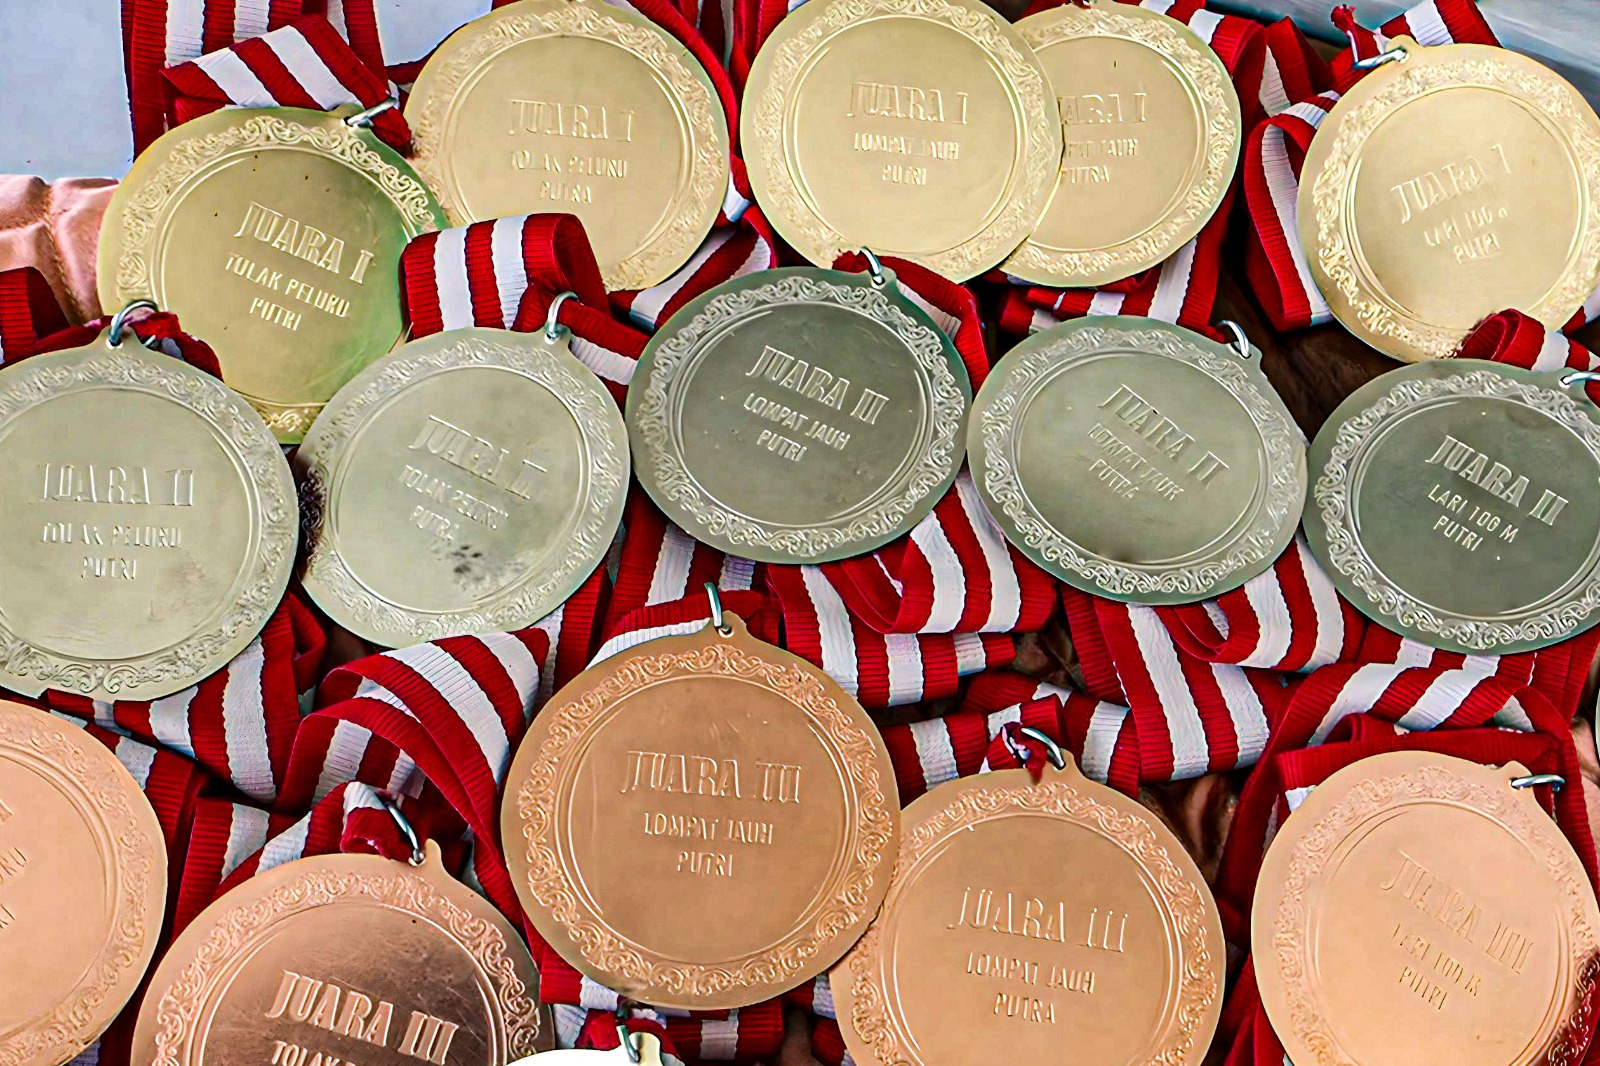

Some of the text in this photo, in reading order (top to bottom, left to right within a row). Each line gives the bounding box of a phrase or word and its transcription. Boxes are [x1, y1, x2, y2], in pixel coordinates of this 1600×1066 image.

[509, 98, 608, 139] JUARA
[846, 81, 969, 125] JUARA I
[1133, 92, 1147, 124] I
[233, 200, 375, 285] JUARA I
[224, 252, 351, 319] TOLAK PELURU
[249, 296, 303, 331] PUTRI
[744, 344, 891, 425] JUARA II
[743, 392, 851, 451] LOMPAT JAUH
[1097, 383, 1230, 491] JUARA II
[756, 428, 808, 462] PUTRI
[36, 461, 151, 505] JUARA
[1424, 434, 1570, 526] JUARA II
[1427, 483, 1520, 544] LARI 100 M
[1432, 514, 1484, 552] PUTRI
[618, 750, 802, 804] JUARA III
[642, 811, 774, 845] LOMPAT JAUH
[677, 851, 733, 877] PUTRI
[947, 886, 1130, 954] JUARA III
[965, 951, 1096, 995] LOMPAT JAUH
[264, 968, 460, 1066] JUARA III
[993, 992, 1056, 1025] PUTRA
